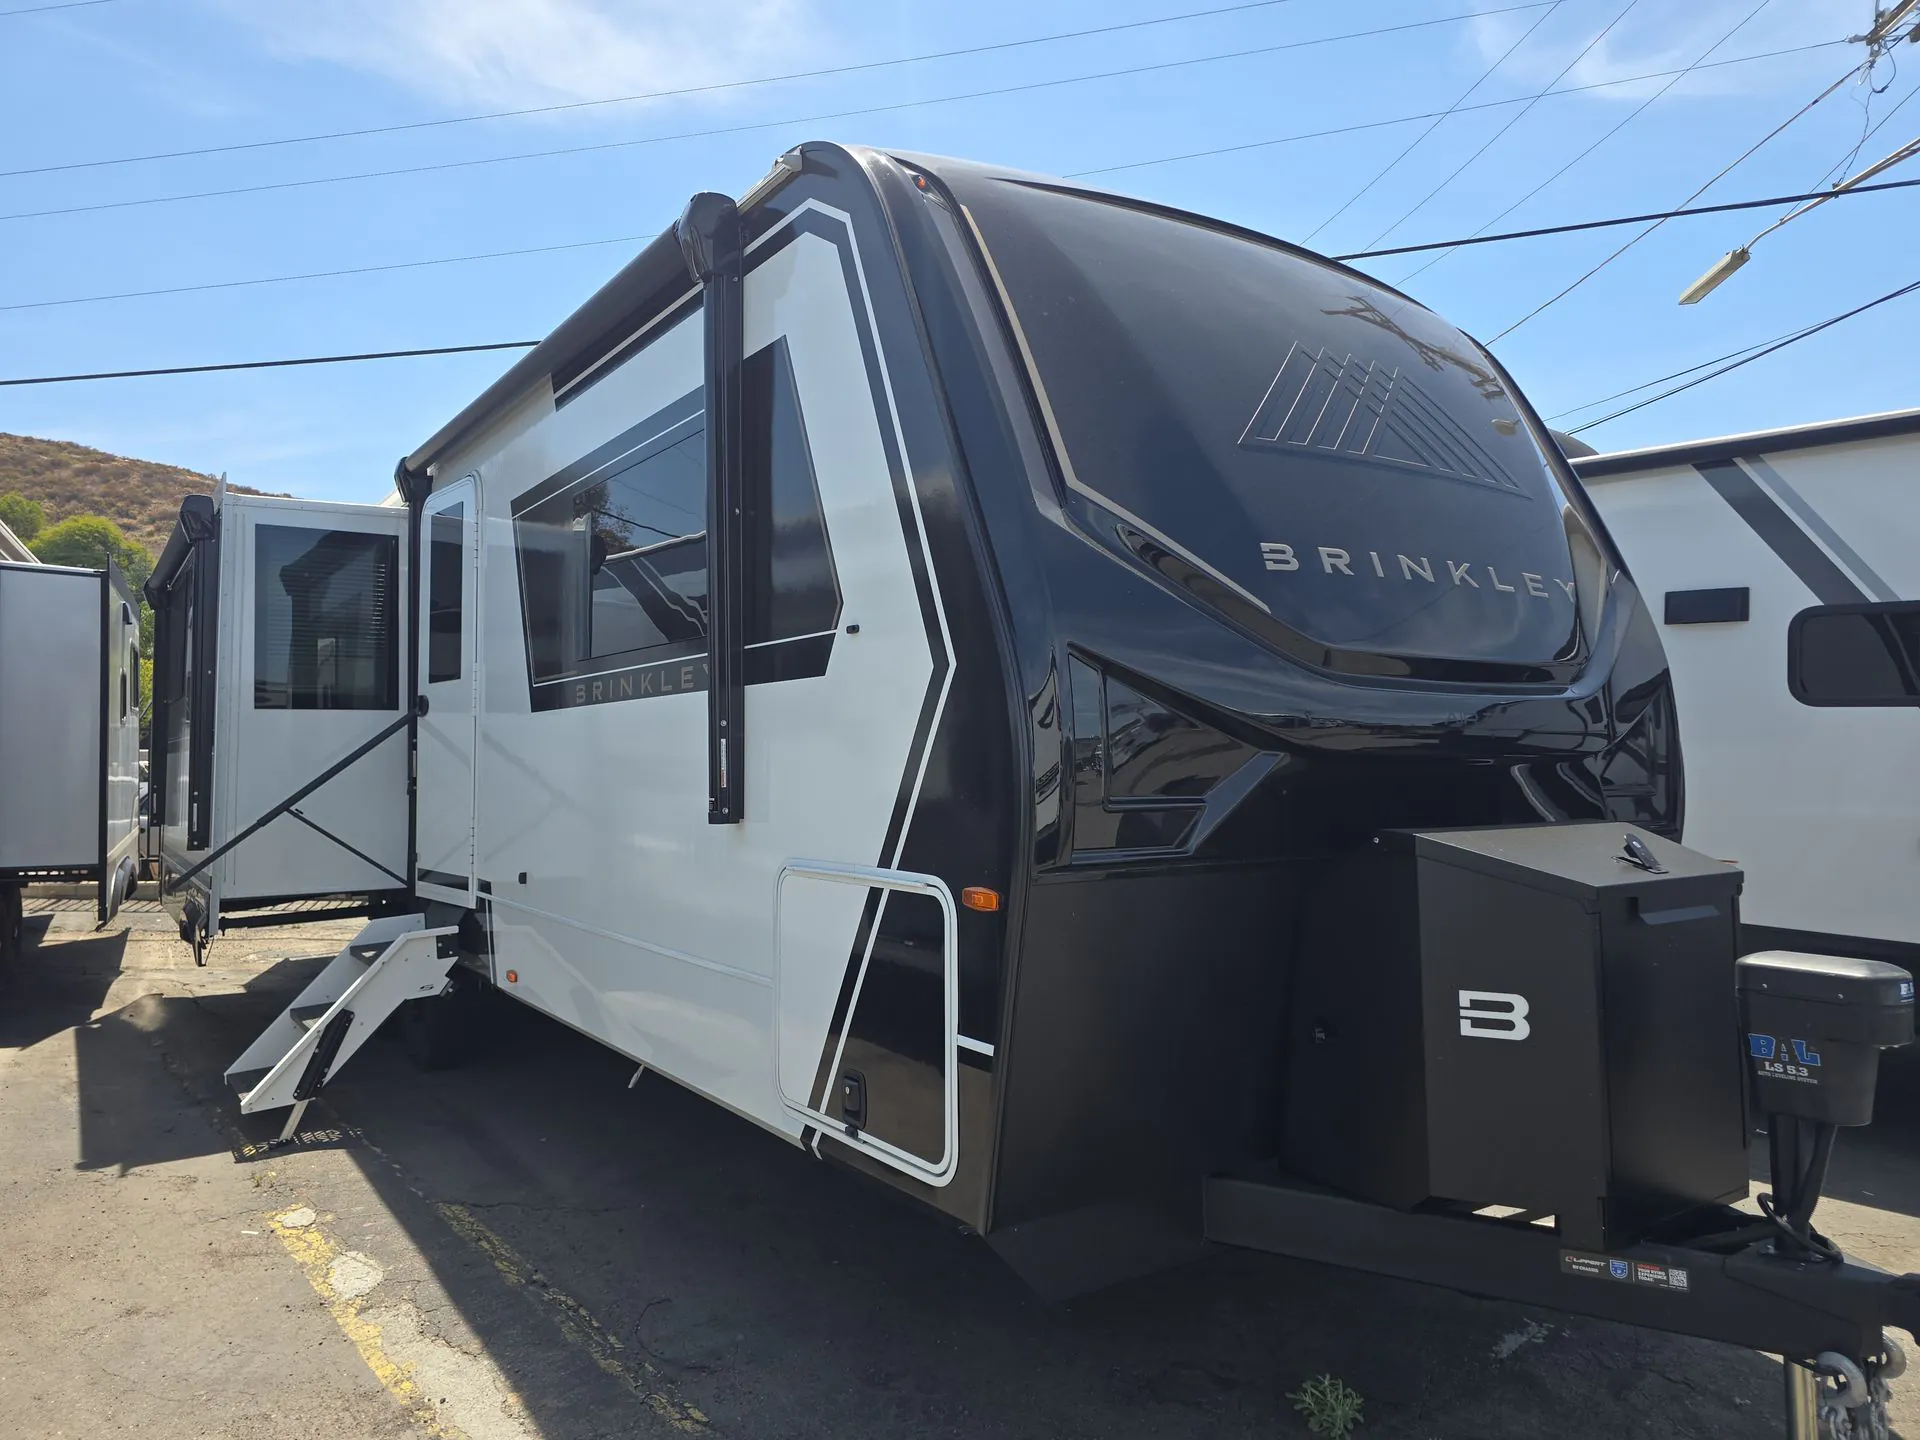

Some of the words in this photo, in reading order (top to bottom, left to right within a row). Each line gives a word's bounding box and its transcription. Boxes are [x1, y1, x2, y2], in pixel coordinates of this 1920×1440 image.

[1259, 542, 1575, 603] BRINKLEY
[1458, 989, 1531, 1041] B
[1763, 1061, 1784, 1073] LS
[1786, 1065, 1809, 1077] 5.3
